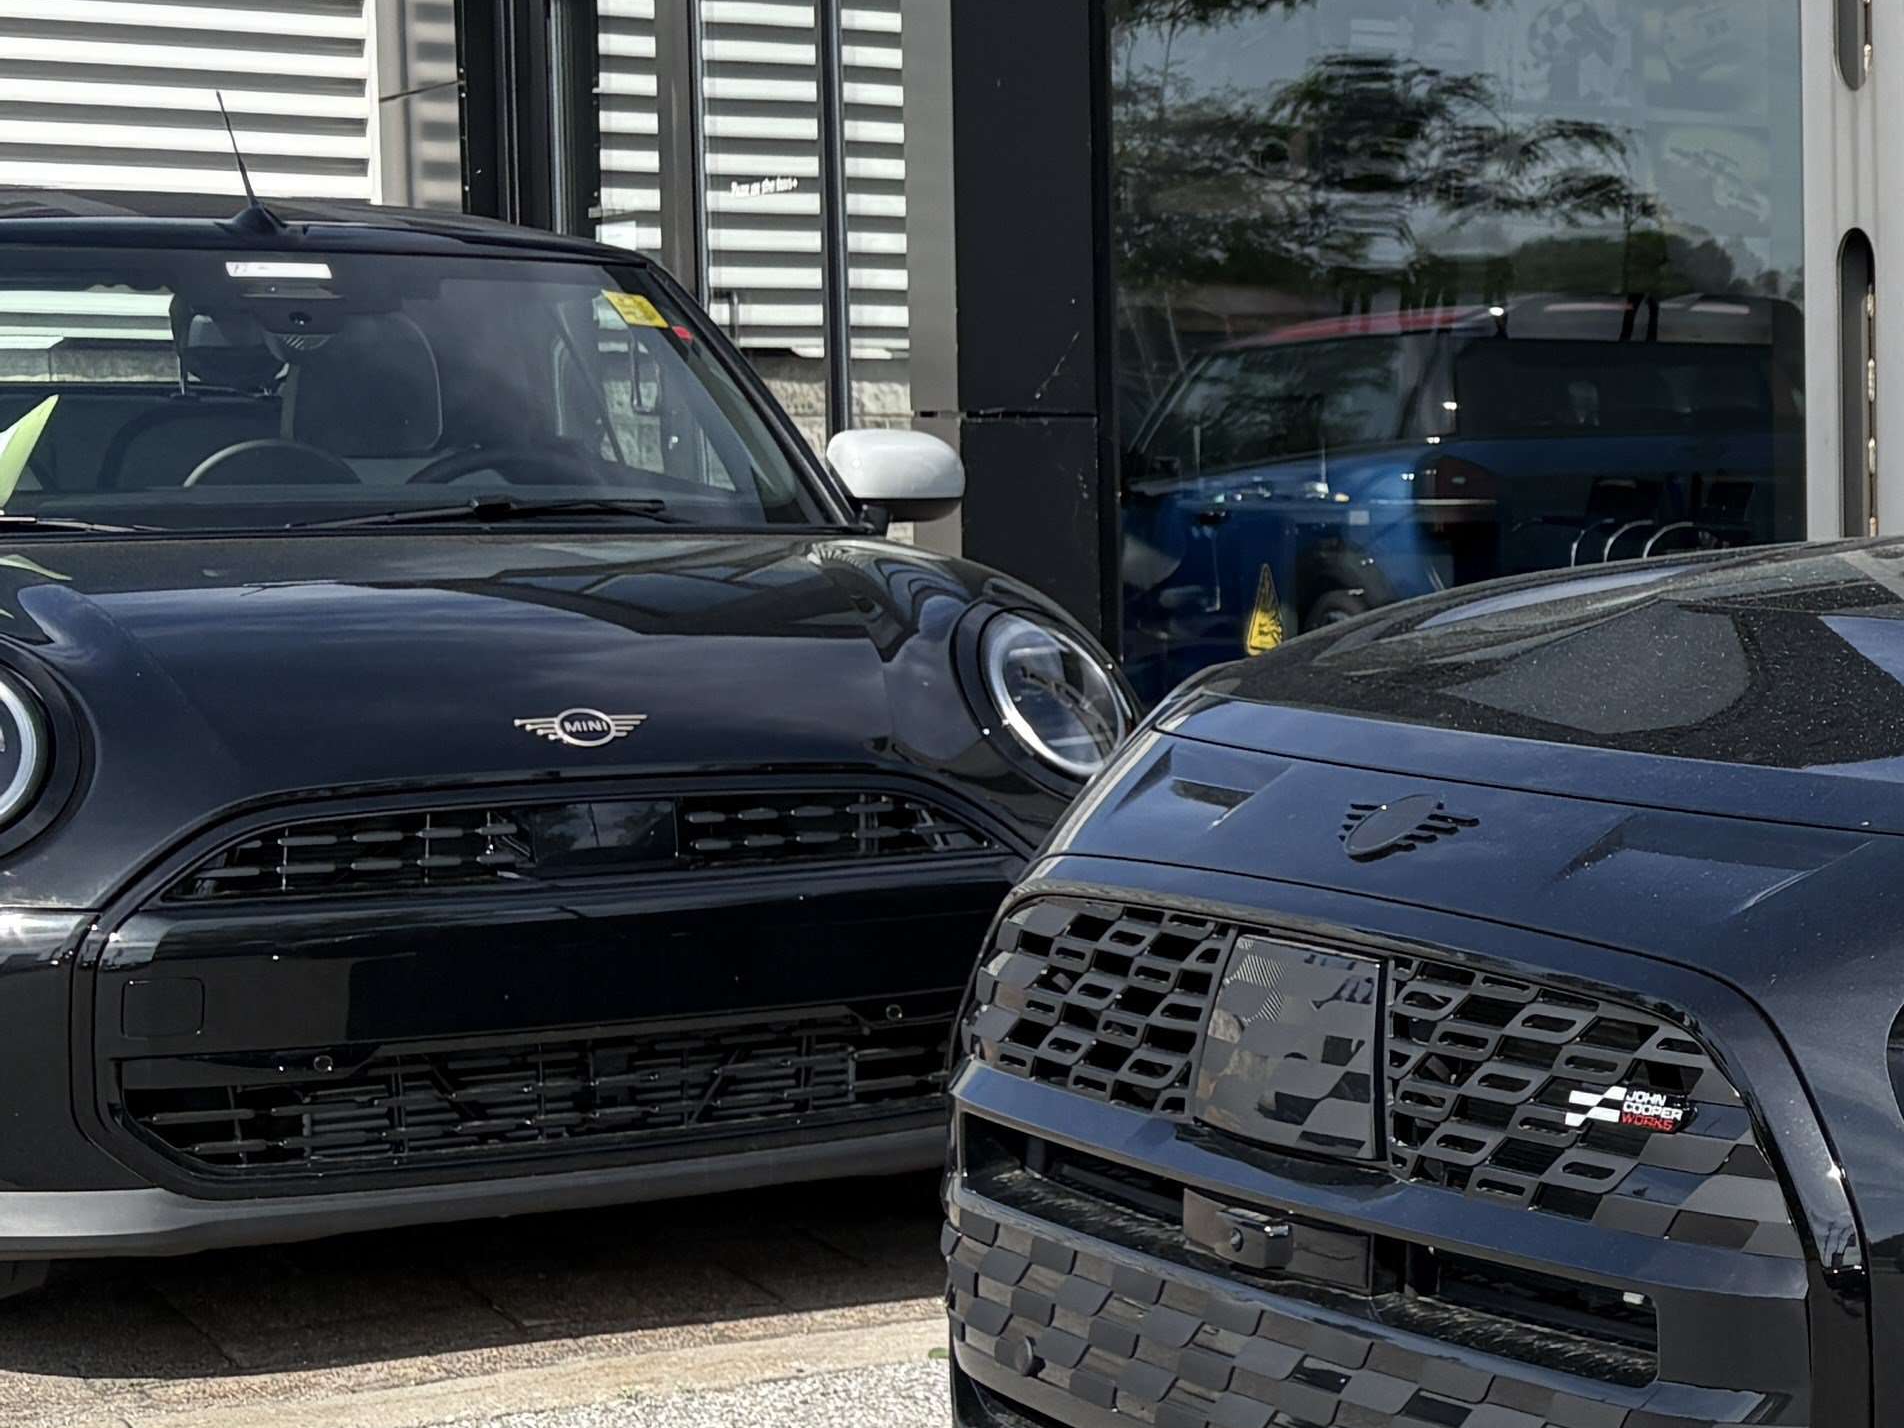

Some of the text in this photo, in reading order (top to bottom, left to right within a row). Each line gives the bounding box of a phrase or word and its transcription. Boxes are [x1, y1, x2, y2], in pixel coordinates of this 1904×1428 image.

[563, 720, 608, 732] MINI
[1626, 1090, 1667, 1106] JOHN
[1623, 1101, 1684, 1121] COOPER
[1622, 1113, 1674, 1131] WORKS
